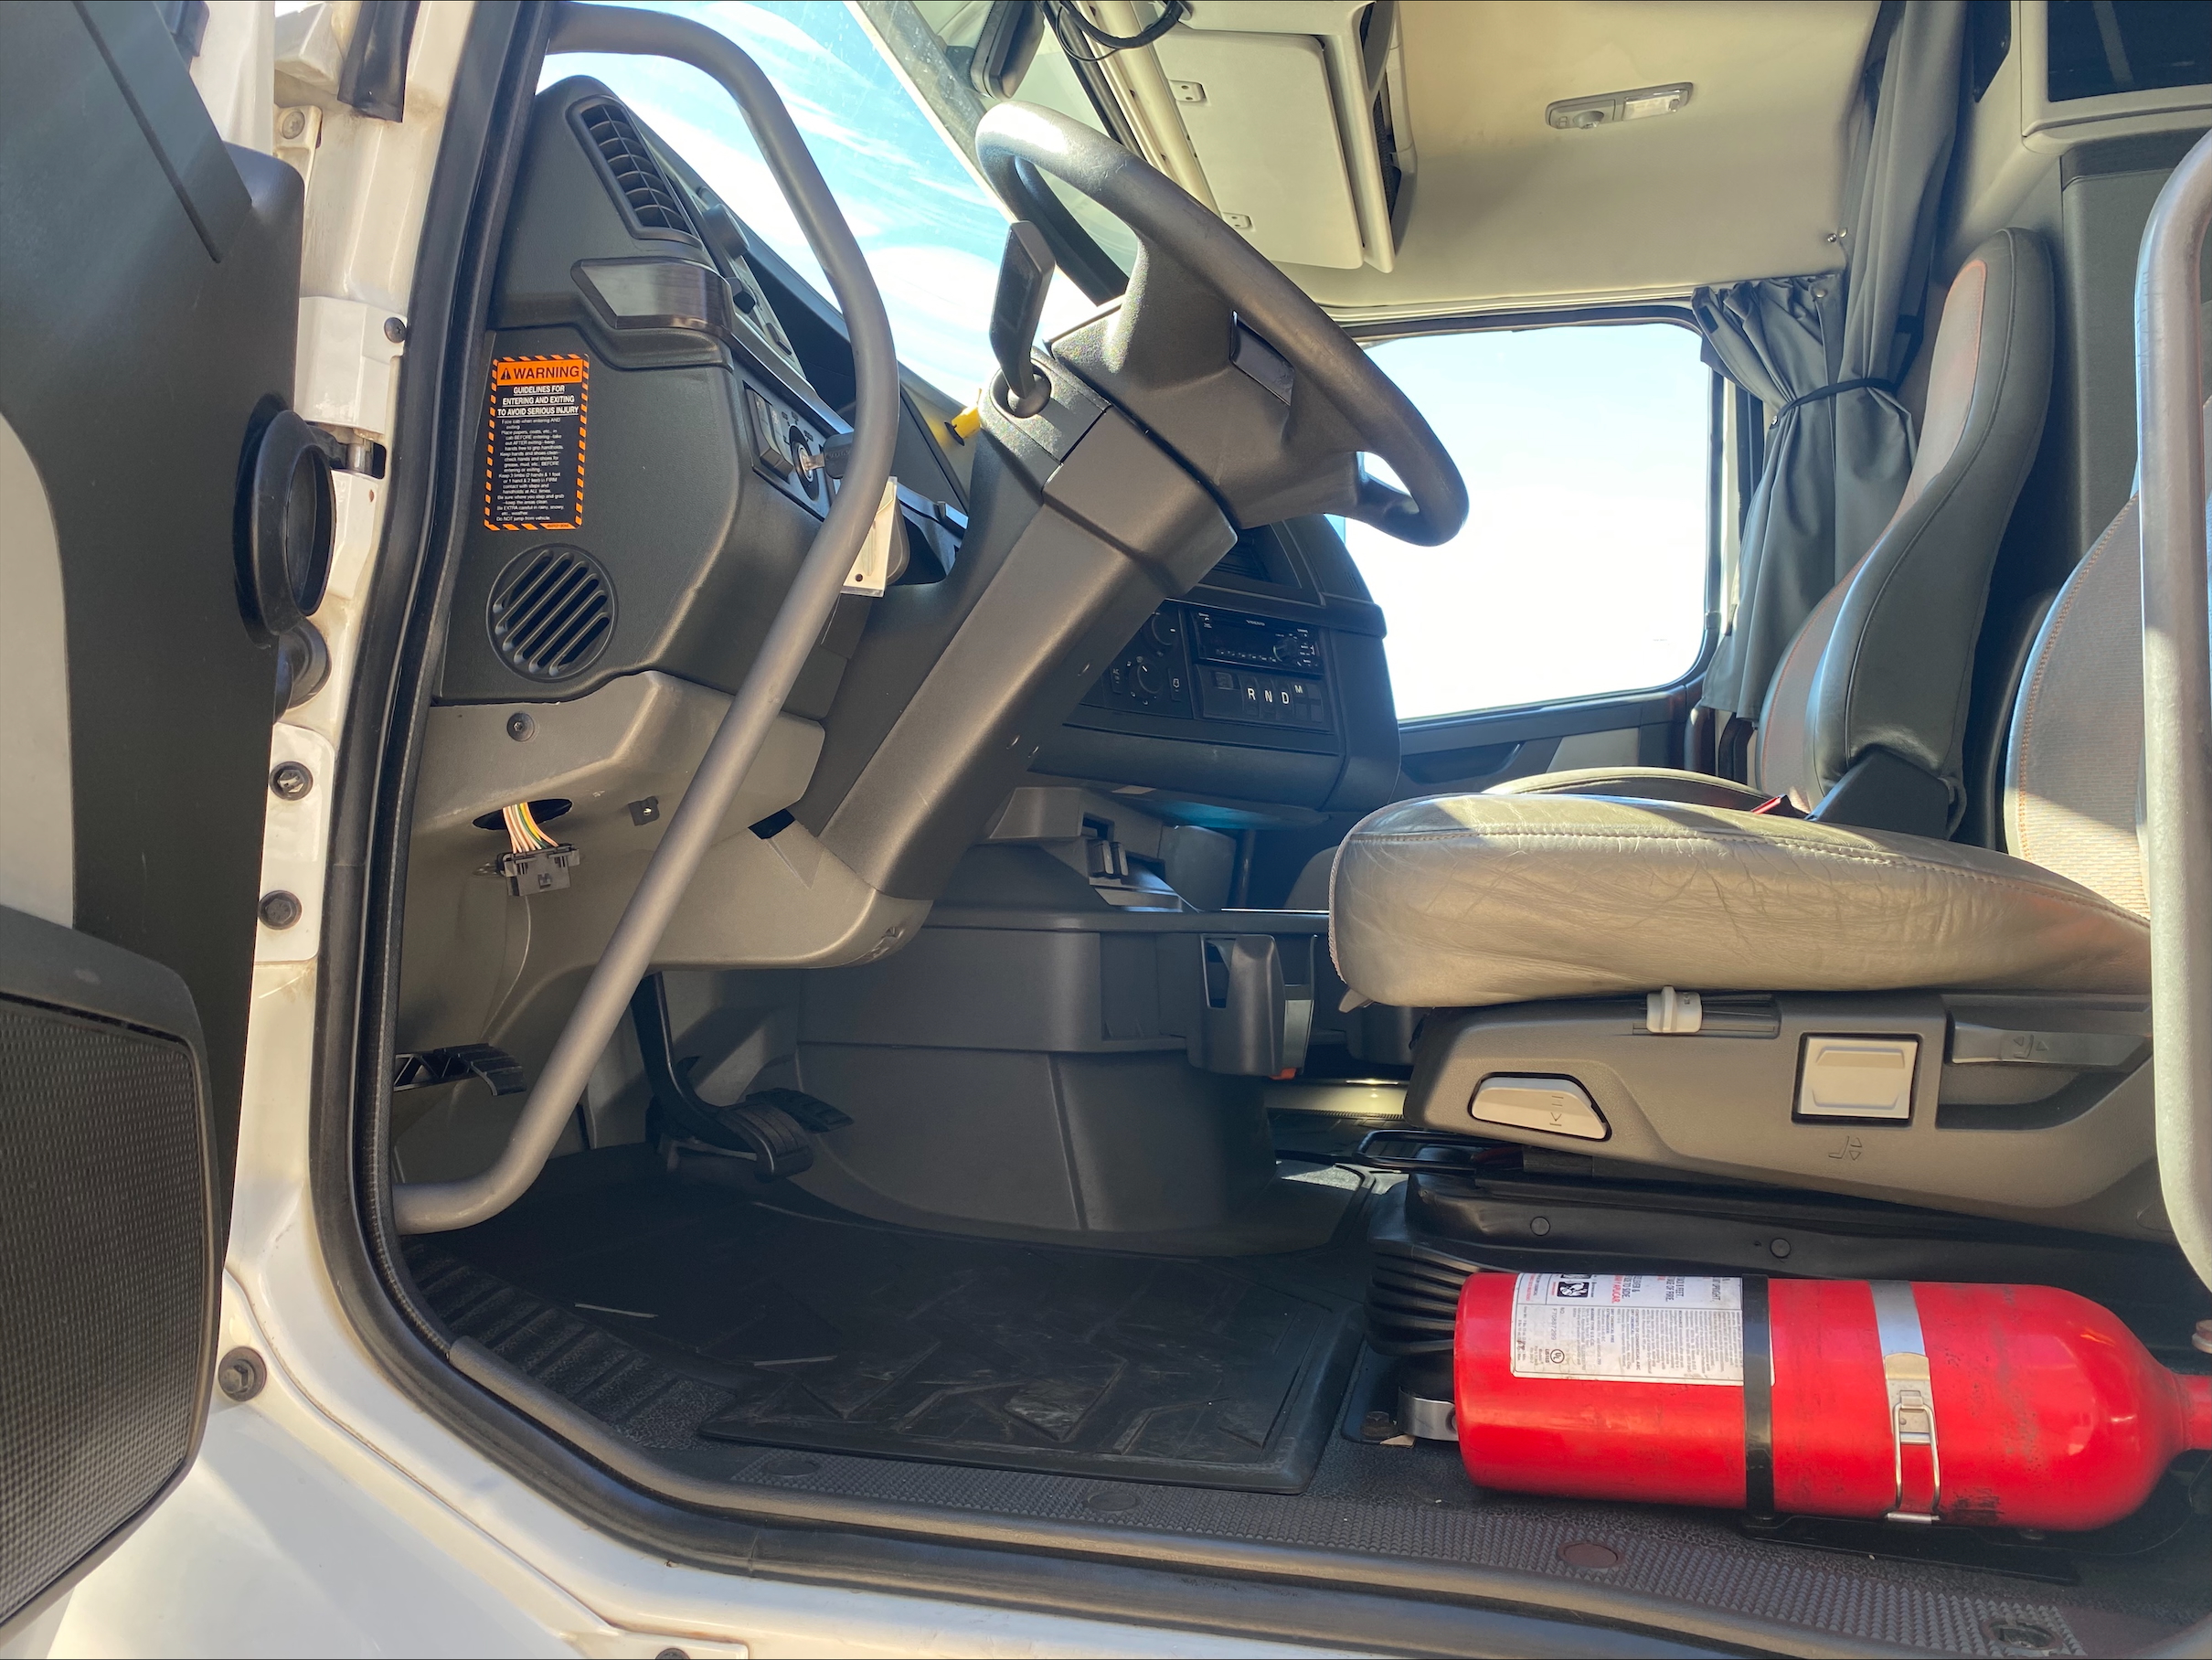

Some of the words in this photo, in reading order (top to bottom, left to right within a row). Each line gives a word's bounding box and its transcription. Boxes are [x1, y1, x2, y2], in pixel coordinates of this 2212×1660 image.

[514, 366, 580, 379] WARNING
[503, 397, 534, 405] ENTERING
[1248, 687, 1256, 700] R
[1264, 690, 1273, 702] N
[1281, 691, 1290, 704] D
[1294, 685, 1303, 694] M
